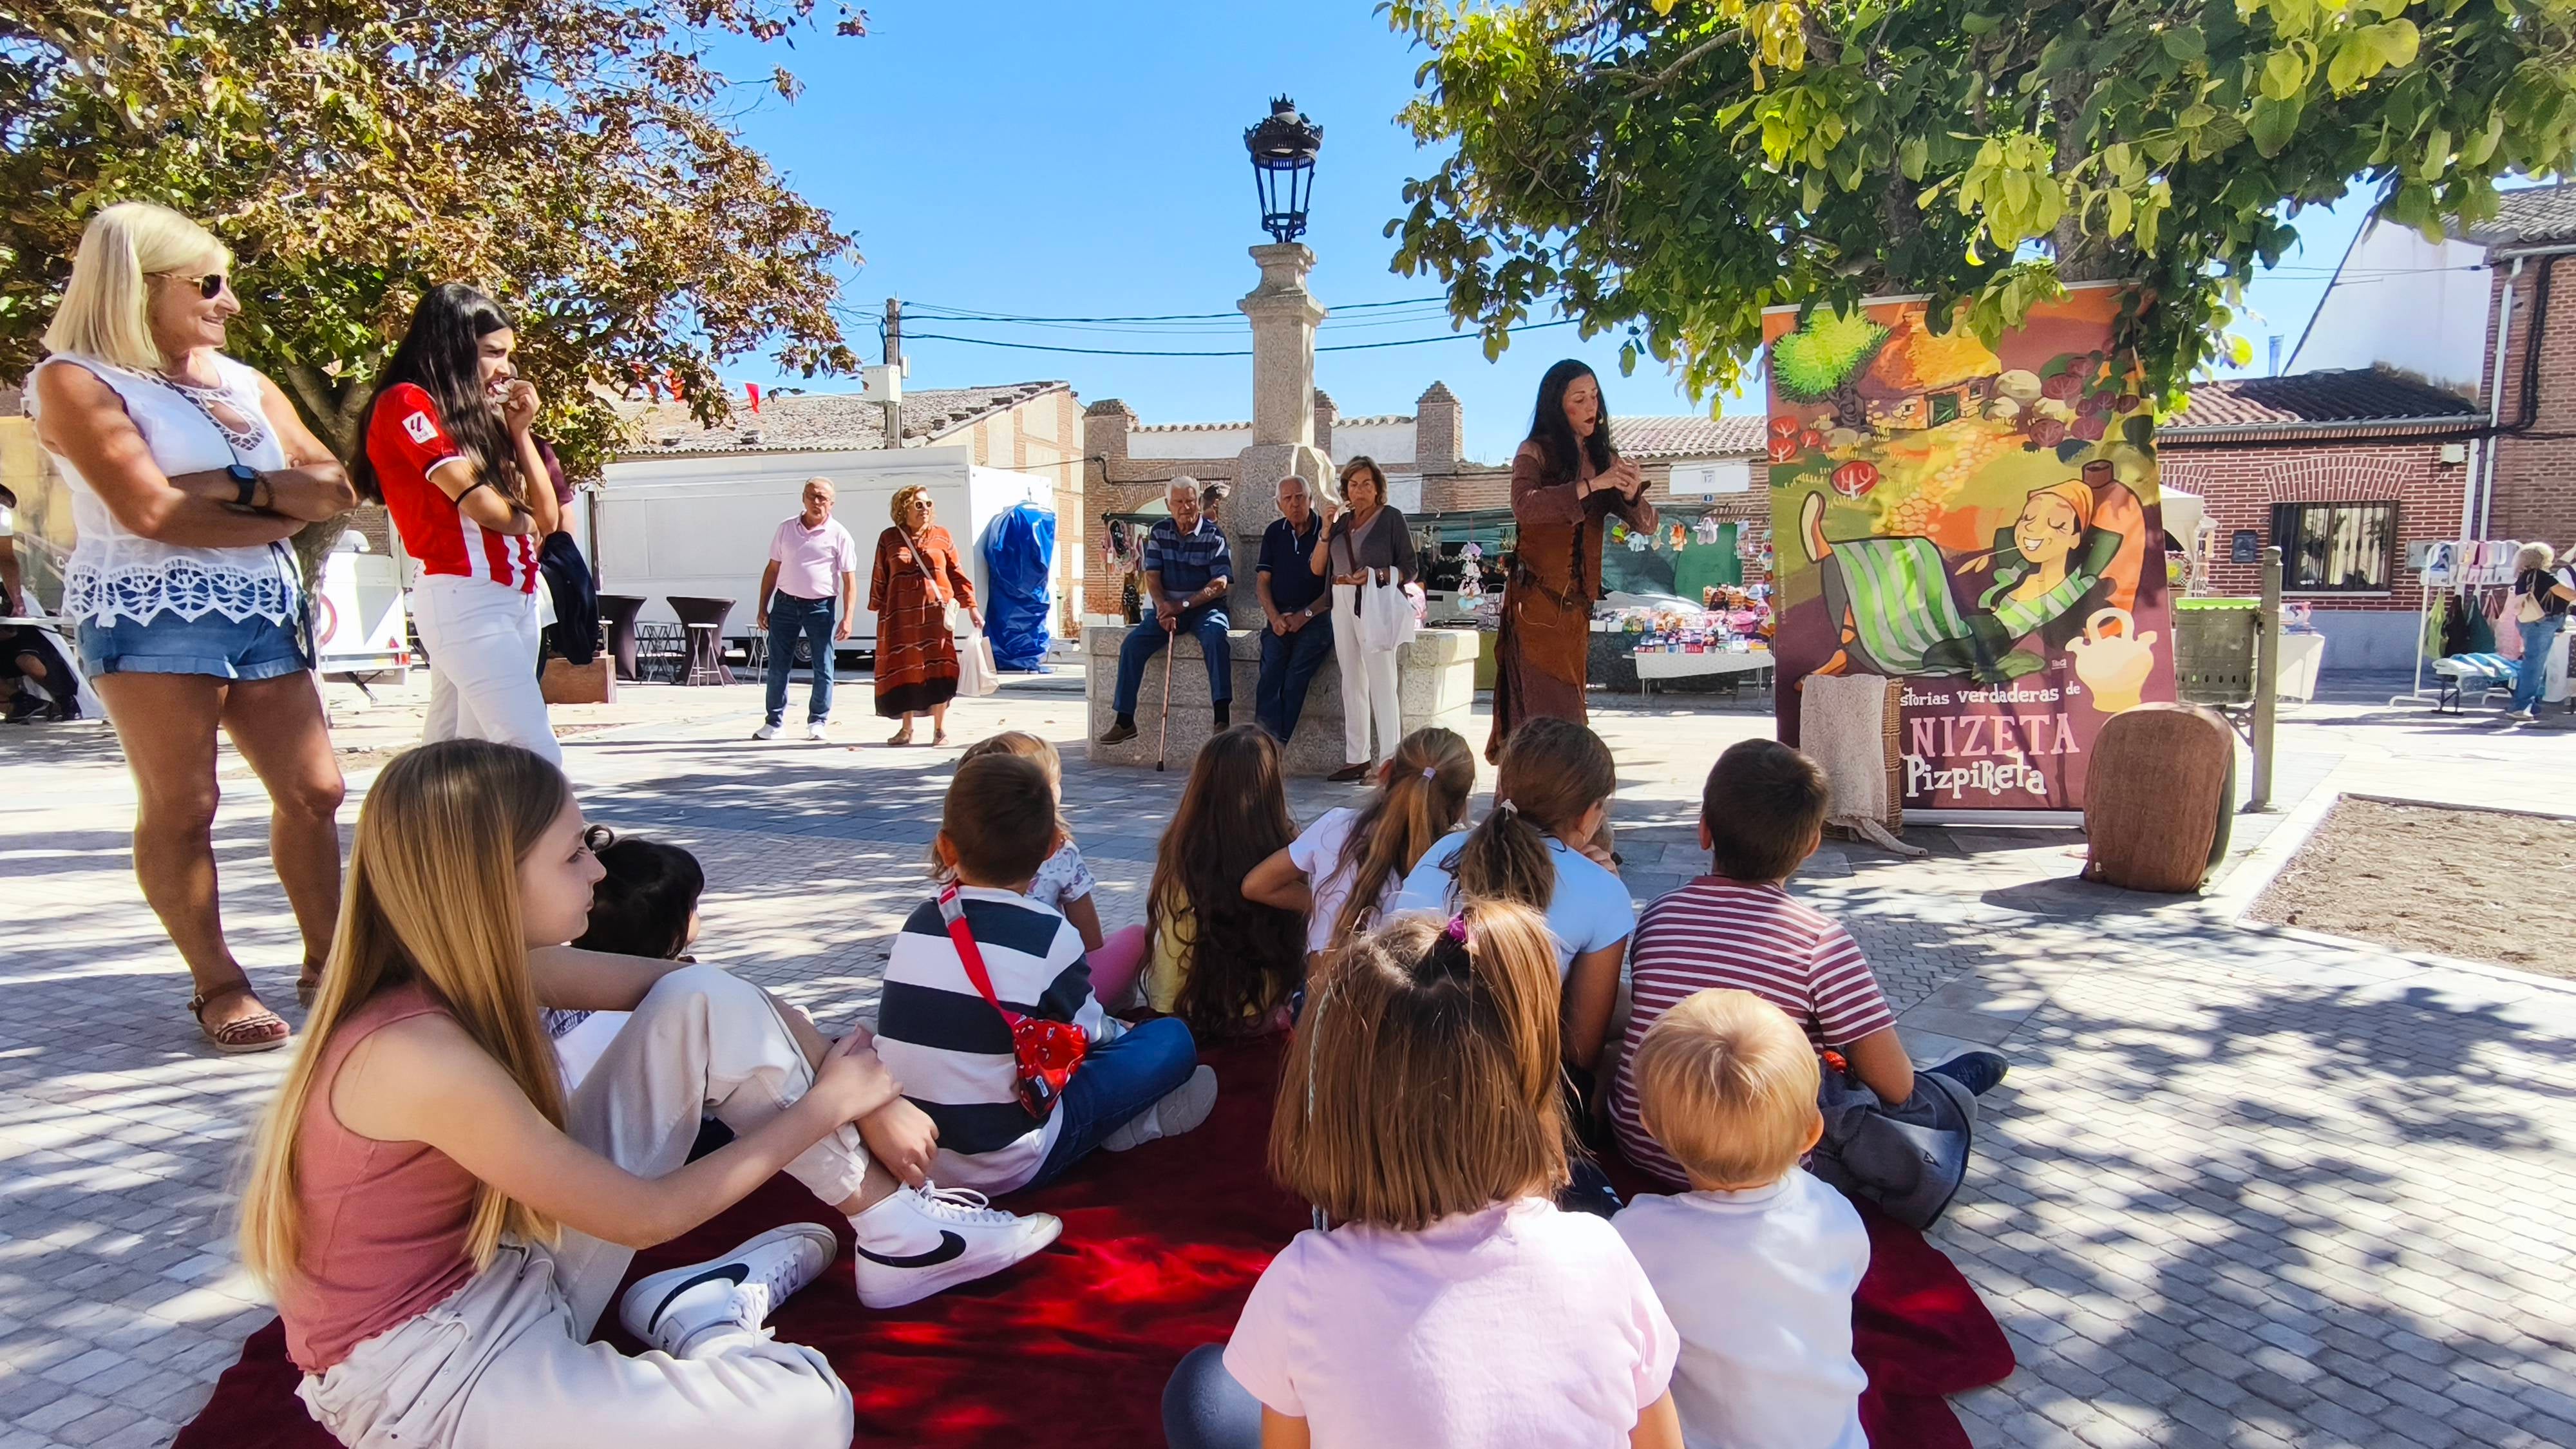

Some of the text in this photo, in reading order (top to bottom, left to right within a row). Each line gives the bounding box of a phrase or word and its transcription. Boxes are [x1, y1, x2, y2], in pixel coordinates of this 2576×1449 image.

[1956, 683, 2059, 703] verdaderas
[2065, 681, 2080, 696] de
[1909, 713, 2080, 757] NIZETA
